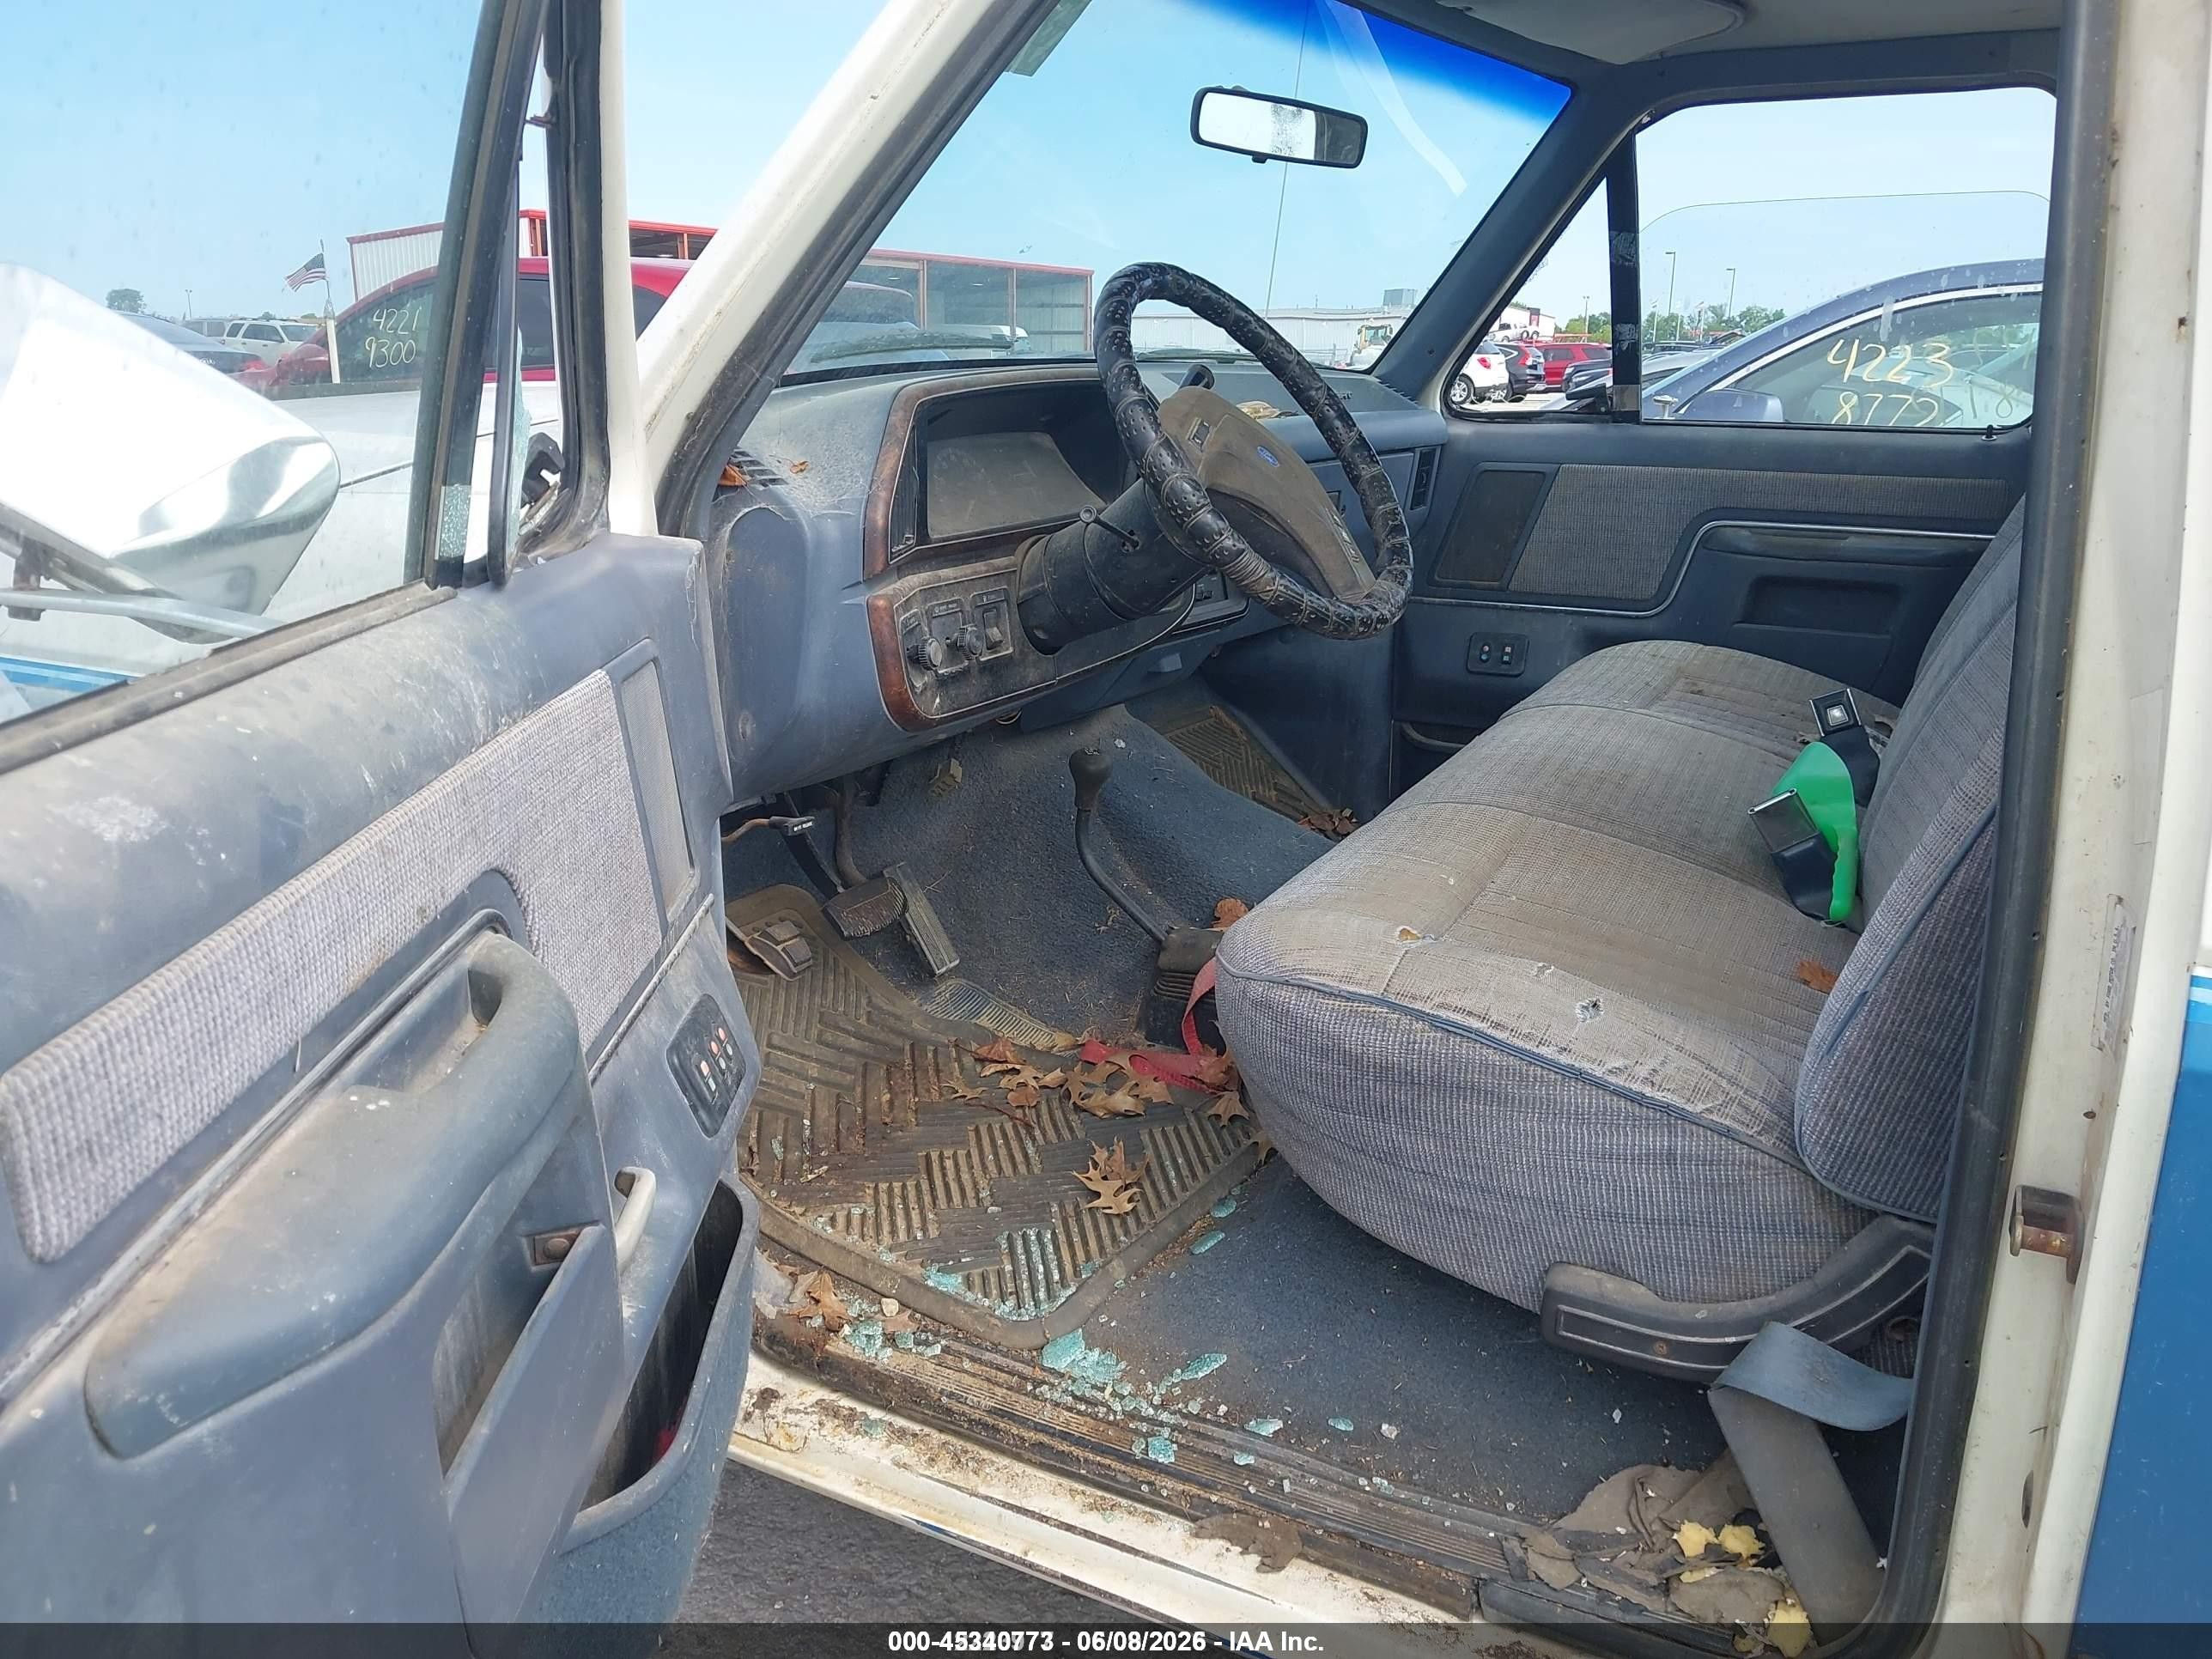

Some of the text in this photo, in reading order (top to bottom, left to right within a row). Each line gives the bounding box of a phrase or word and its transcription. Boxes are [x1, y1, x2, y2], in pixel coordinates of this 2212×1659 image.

[373, 306, 422, 335] 4221
[365, 336, 416, 368] 9300
[1826, 338, 1954, 387] 4223
[1832, 391, 1939, 428] 8772
